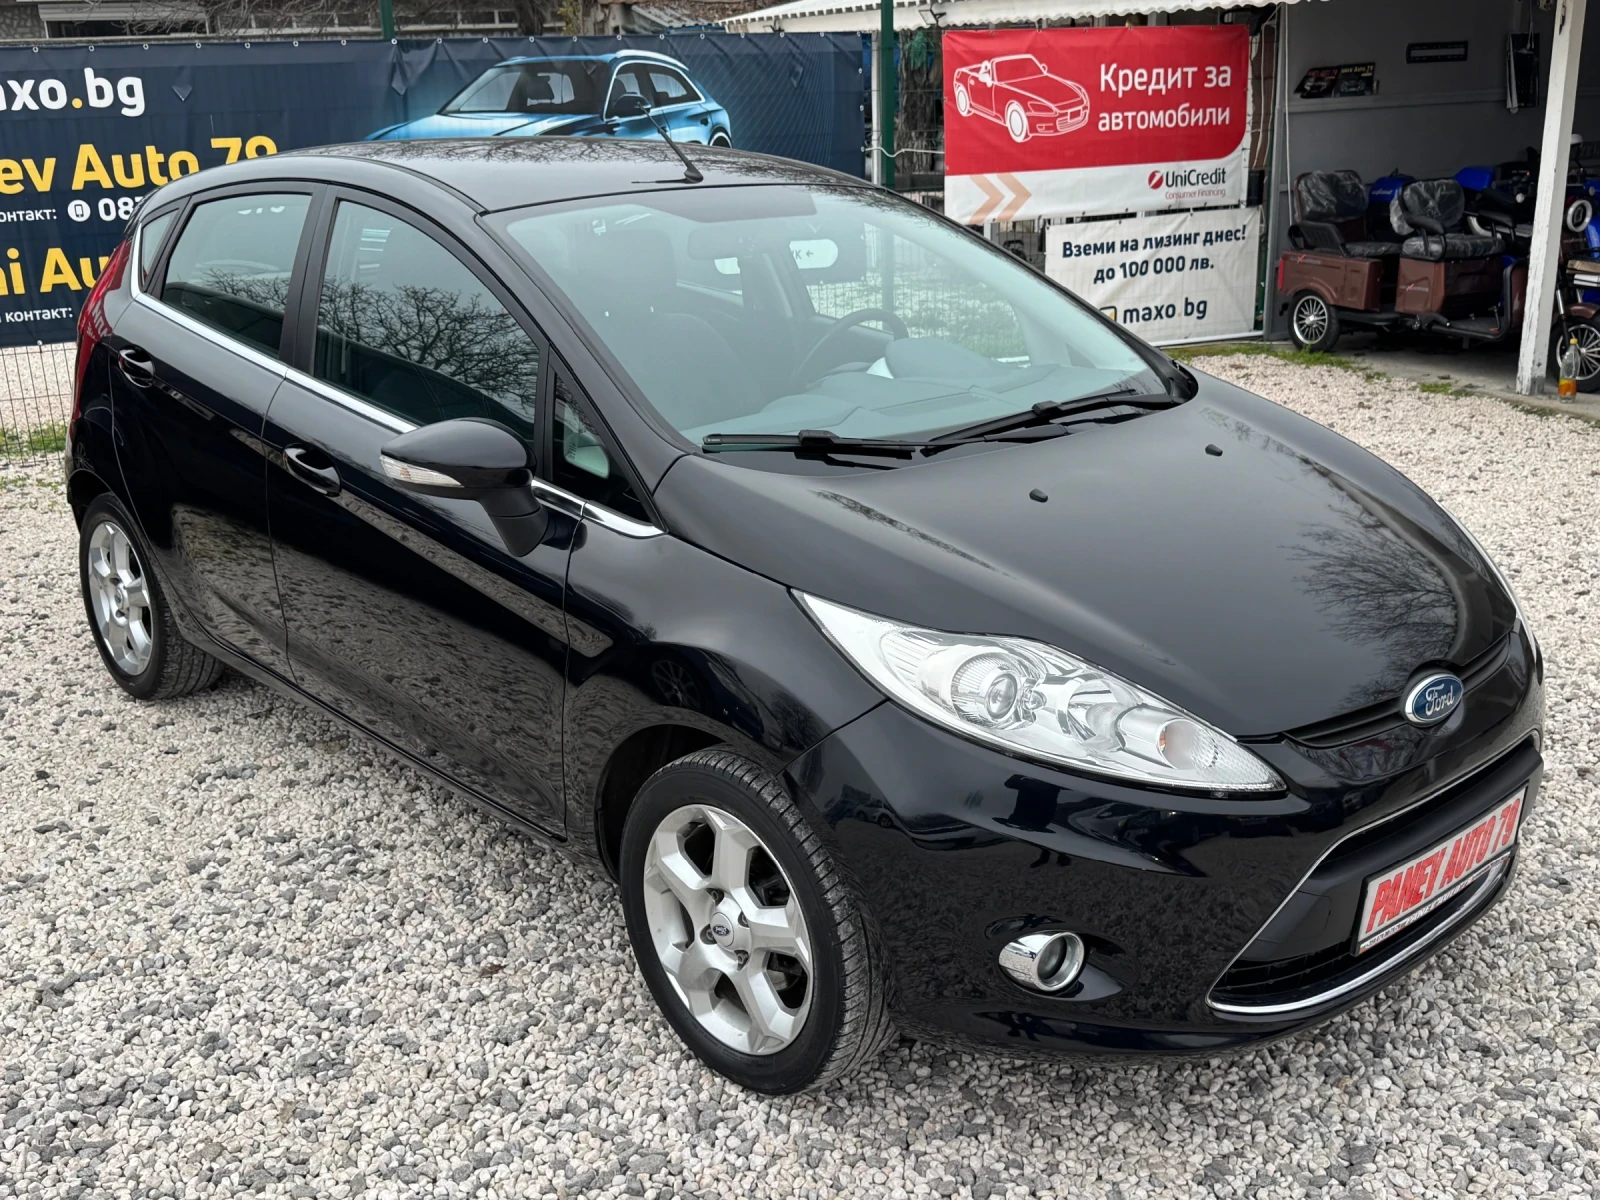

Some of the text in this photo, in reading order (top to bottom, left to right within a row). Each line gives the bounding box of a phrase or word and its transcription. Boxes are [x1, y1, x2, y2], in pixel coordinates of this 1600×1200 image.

[0, 67, 146, 117] xo.bg
[1100, 63, 1231, 98] Кредит за
[1098, 102, 1231, 131] автомобили
[72, 143, 200, 191] Auto
[1165, 168, 1226, 188] UniCredit
[1165, 188, 1226, 200] Consumer Financing
[1062, 224, 1247, 258] Вземи на лизинг днес!
[1093, 256, 1215, 284] до 100 000 лв.
[5, 307, 73, 323] контакт:
[1123, 297, 1208, 324] maxo.bg
[1425, 683, 1455, 715] Ford
[1439, 815, 1497, 889] AUTO
[1492, 798, 1521, 855] 79
